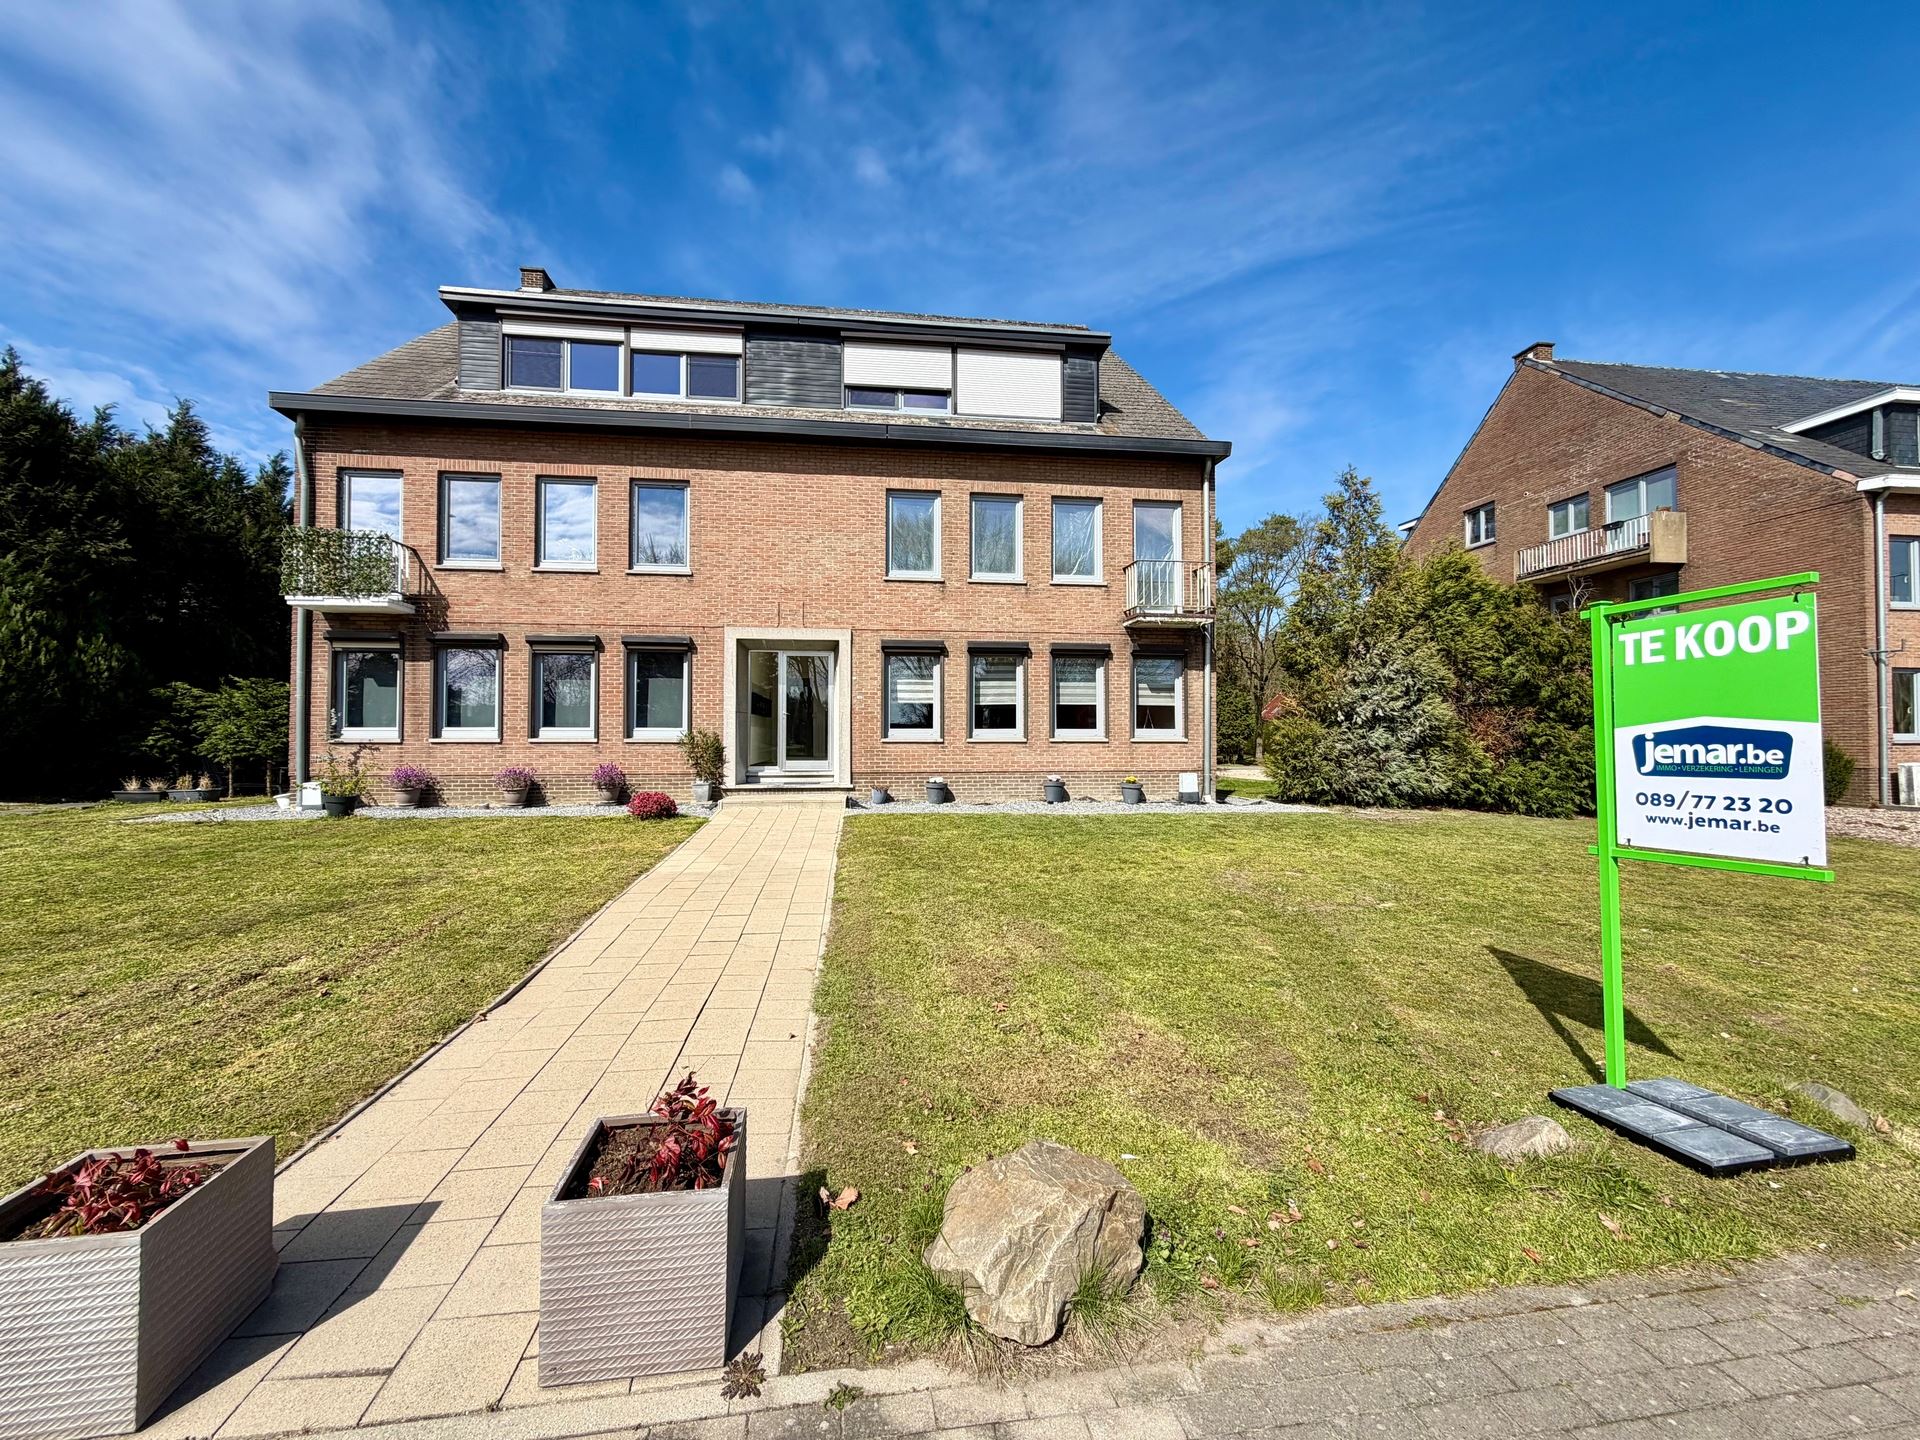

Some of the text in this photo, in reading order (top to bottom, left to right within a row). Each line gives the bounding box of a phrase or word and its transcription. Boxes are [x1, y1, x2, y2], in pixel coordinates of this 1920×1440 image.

[1618, 610, 1810, 666] TE KOOP
[1640, 731, 1784, 774] jemar.be
[1656, 764, 1783, 774] IMMO VERZEKERING LENINGEN
[1635, 790, 1793, 815] 089/77 23 20
[1646, 812, 1781, 834] www.jemar.be
